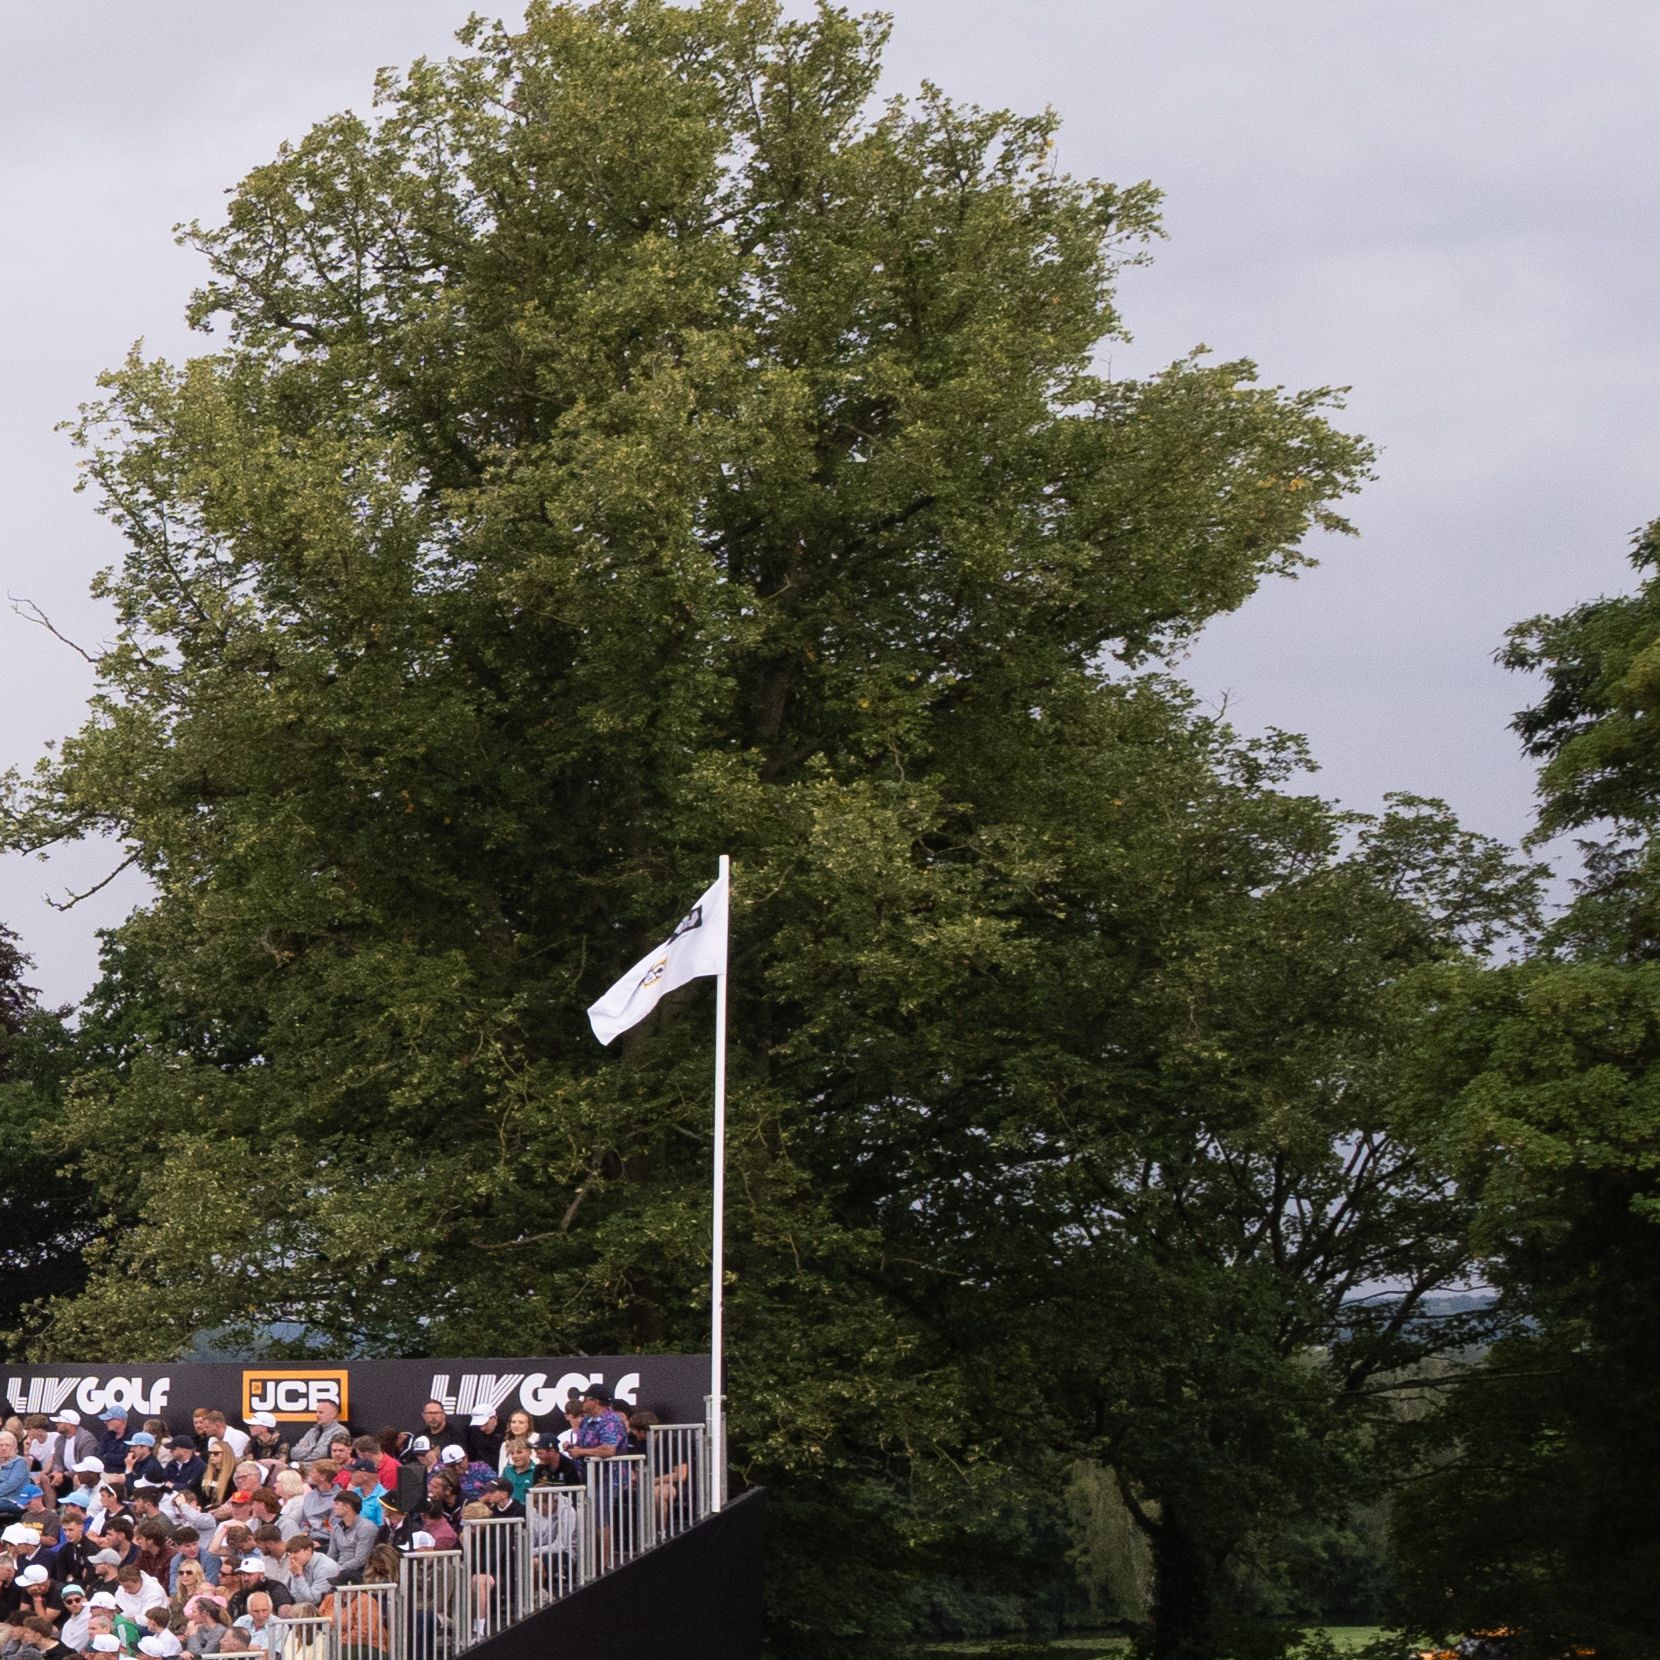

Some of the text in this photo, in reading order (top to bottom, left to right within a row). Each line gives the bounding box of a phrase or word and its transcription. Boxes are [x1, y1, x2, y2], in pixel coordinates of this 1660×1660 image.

[6, 1376, 170, 1415] LIV GOLF
[251, 1381, 340, 1411] JCB
[519, 1372, 641, 1416] GOF
